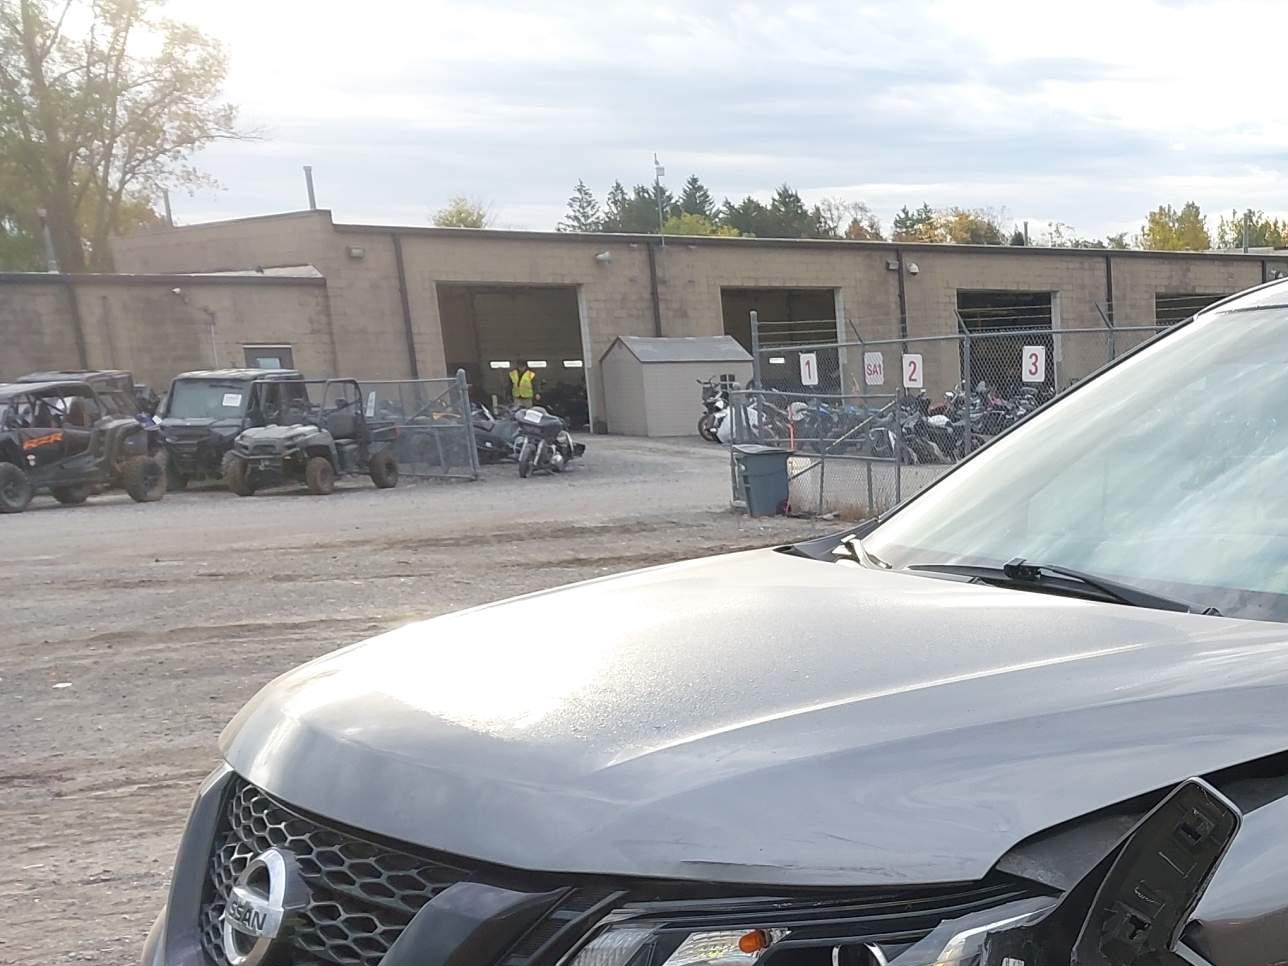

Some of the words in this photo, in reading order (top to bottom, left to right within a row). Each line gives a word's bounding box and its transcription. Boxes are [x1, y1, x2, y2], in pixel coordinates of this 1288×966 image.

[805, 359, 812, 381] 1
[908, 360, 918, 382] 2
[1028, 352, 1039, 376] 3
[228, 899, 267, 931] SSAN
